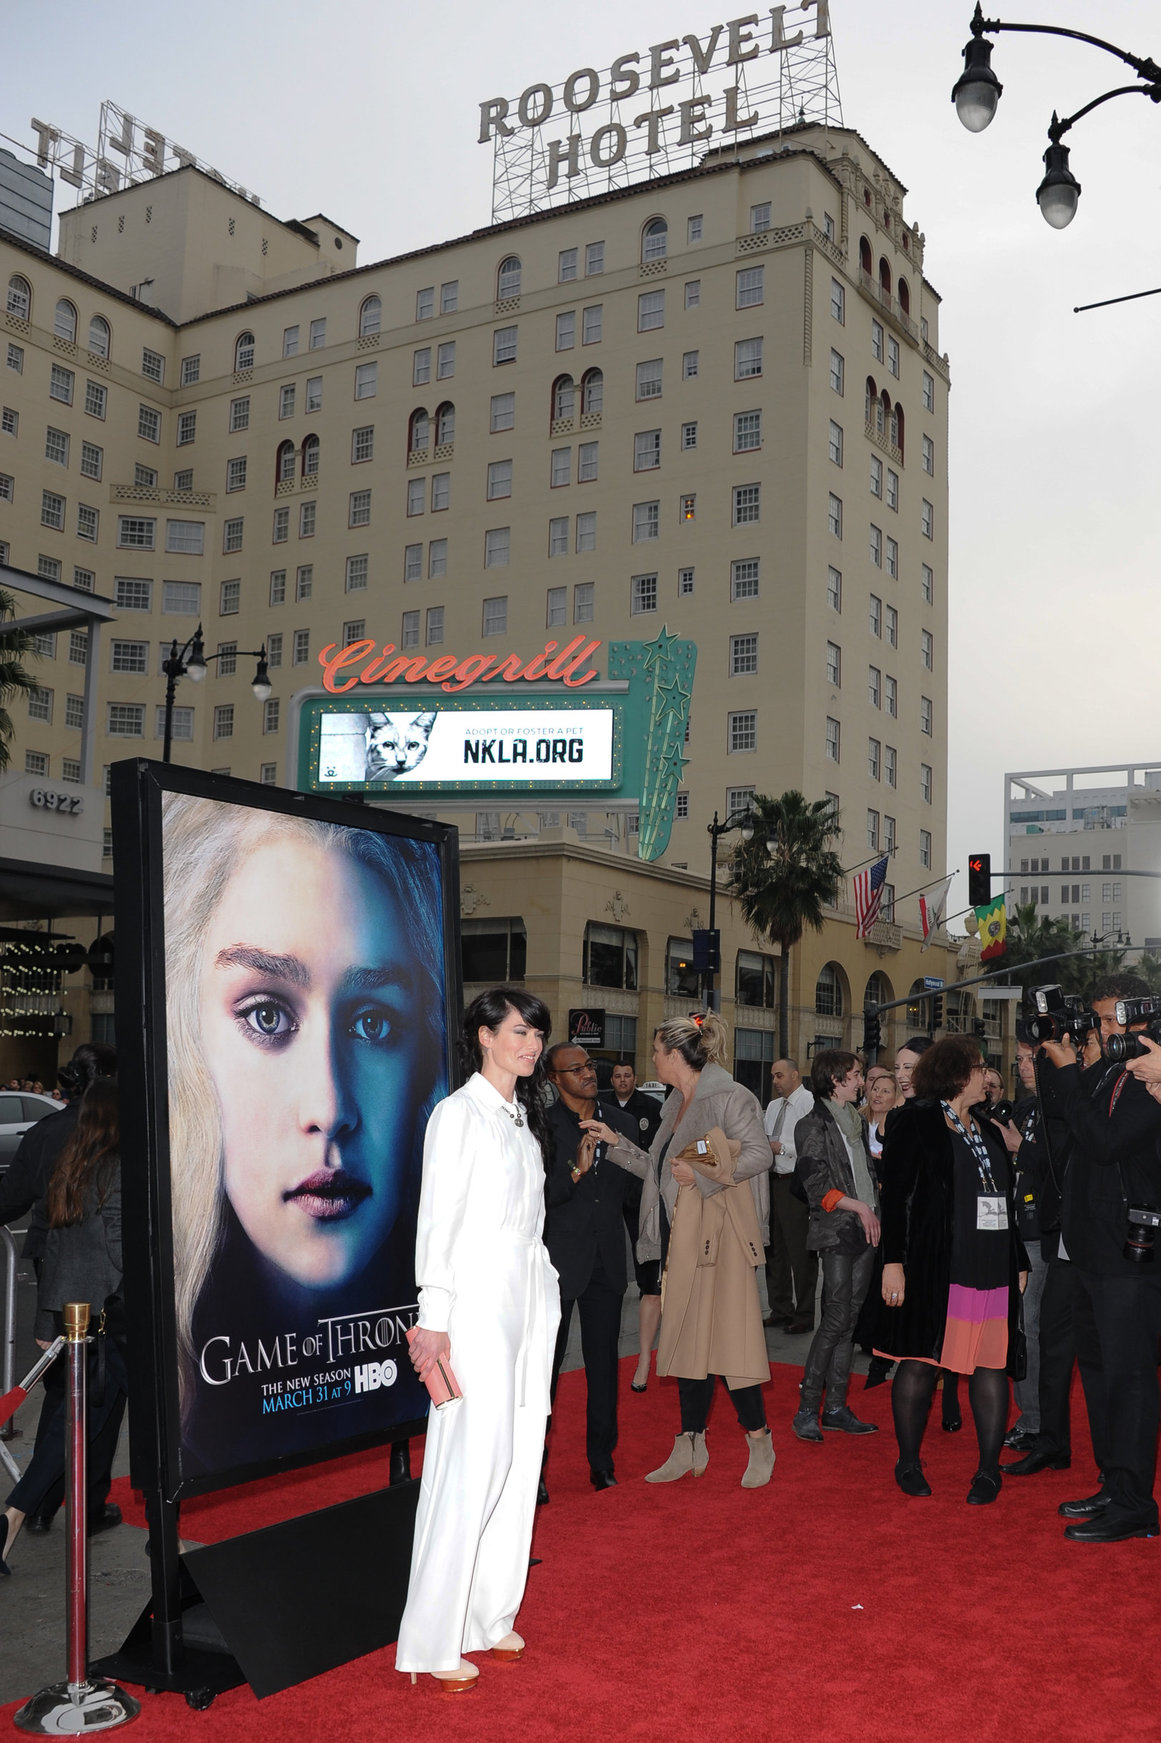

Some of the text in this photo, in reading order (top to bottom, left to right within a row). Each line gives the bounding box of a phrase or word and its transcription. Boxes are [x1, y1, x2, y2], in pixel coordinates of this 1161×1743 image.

[478, 0, 832, 144] ROOSEVELT
[547, 86, 759, 190] HOTEL
[318, 635, 602, 693] Cinegrill
[566, 727, 584, 735] PET
[464, 738, 583, 763] NKLA.ORG
[29, 788, 84, 815] 6922
[570, 1011, 602, 1035] Public
[200, 1304, 420, 1386] GAME OF THRON
[261, 1368, 352, 1396] THE NEW SEASON
[354, 1359, 398, 1394] HBO
[262, 1380, 353, 1414] MARCH 31 AT 9
